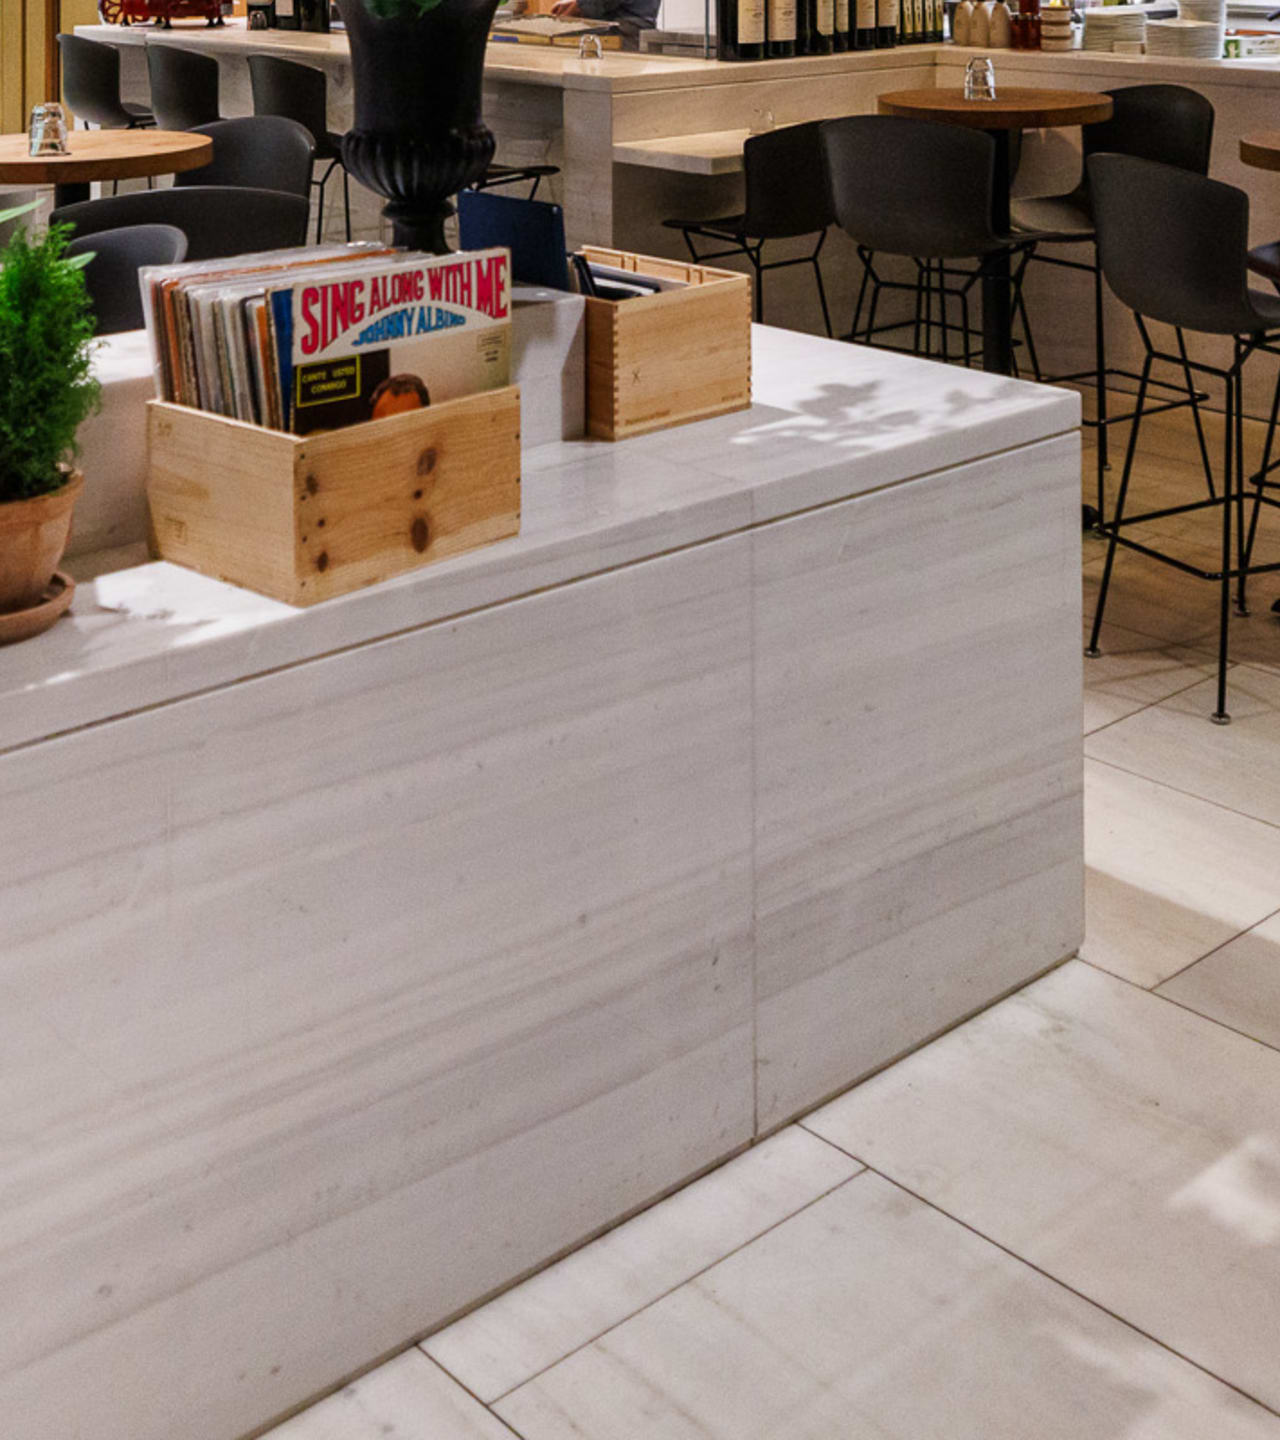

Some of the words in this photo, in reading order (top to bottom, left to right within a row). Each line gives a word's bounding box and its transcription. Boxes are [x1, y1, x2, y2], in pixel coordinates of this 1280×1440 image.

[301, 279, 365, 356] SING
[368, 269, 425, 317] ALONG
[426, 259, 472, 309] WITH
[474, 254, 509, 320] ME
[352, 306, 417, 347] JOHNNY
[416, 305, 468, 334] ALBINO
